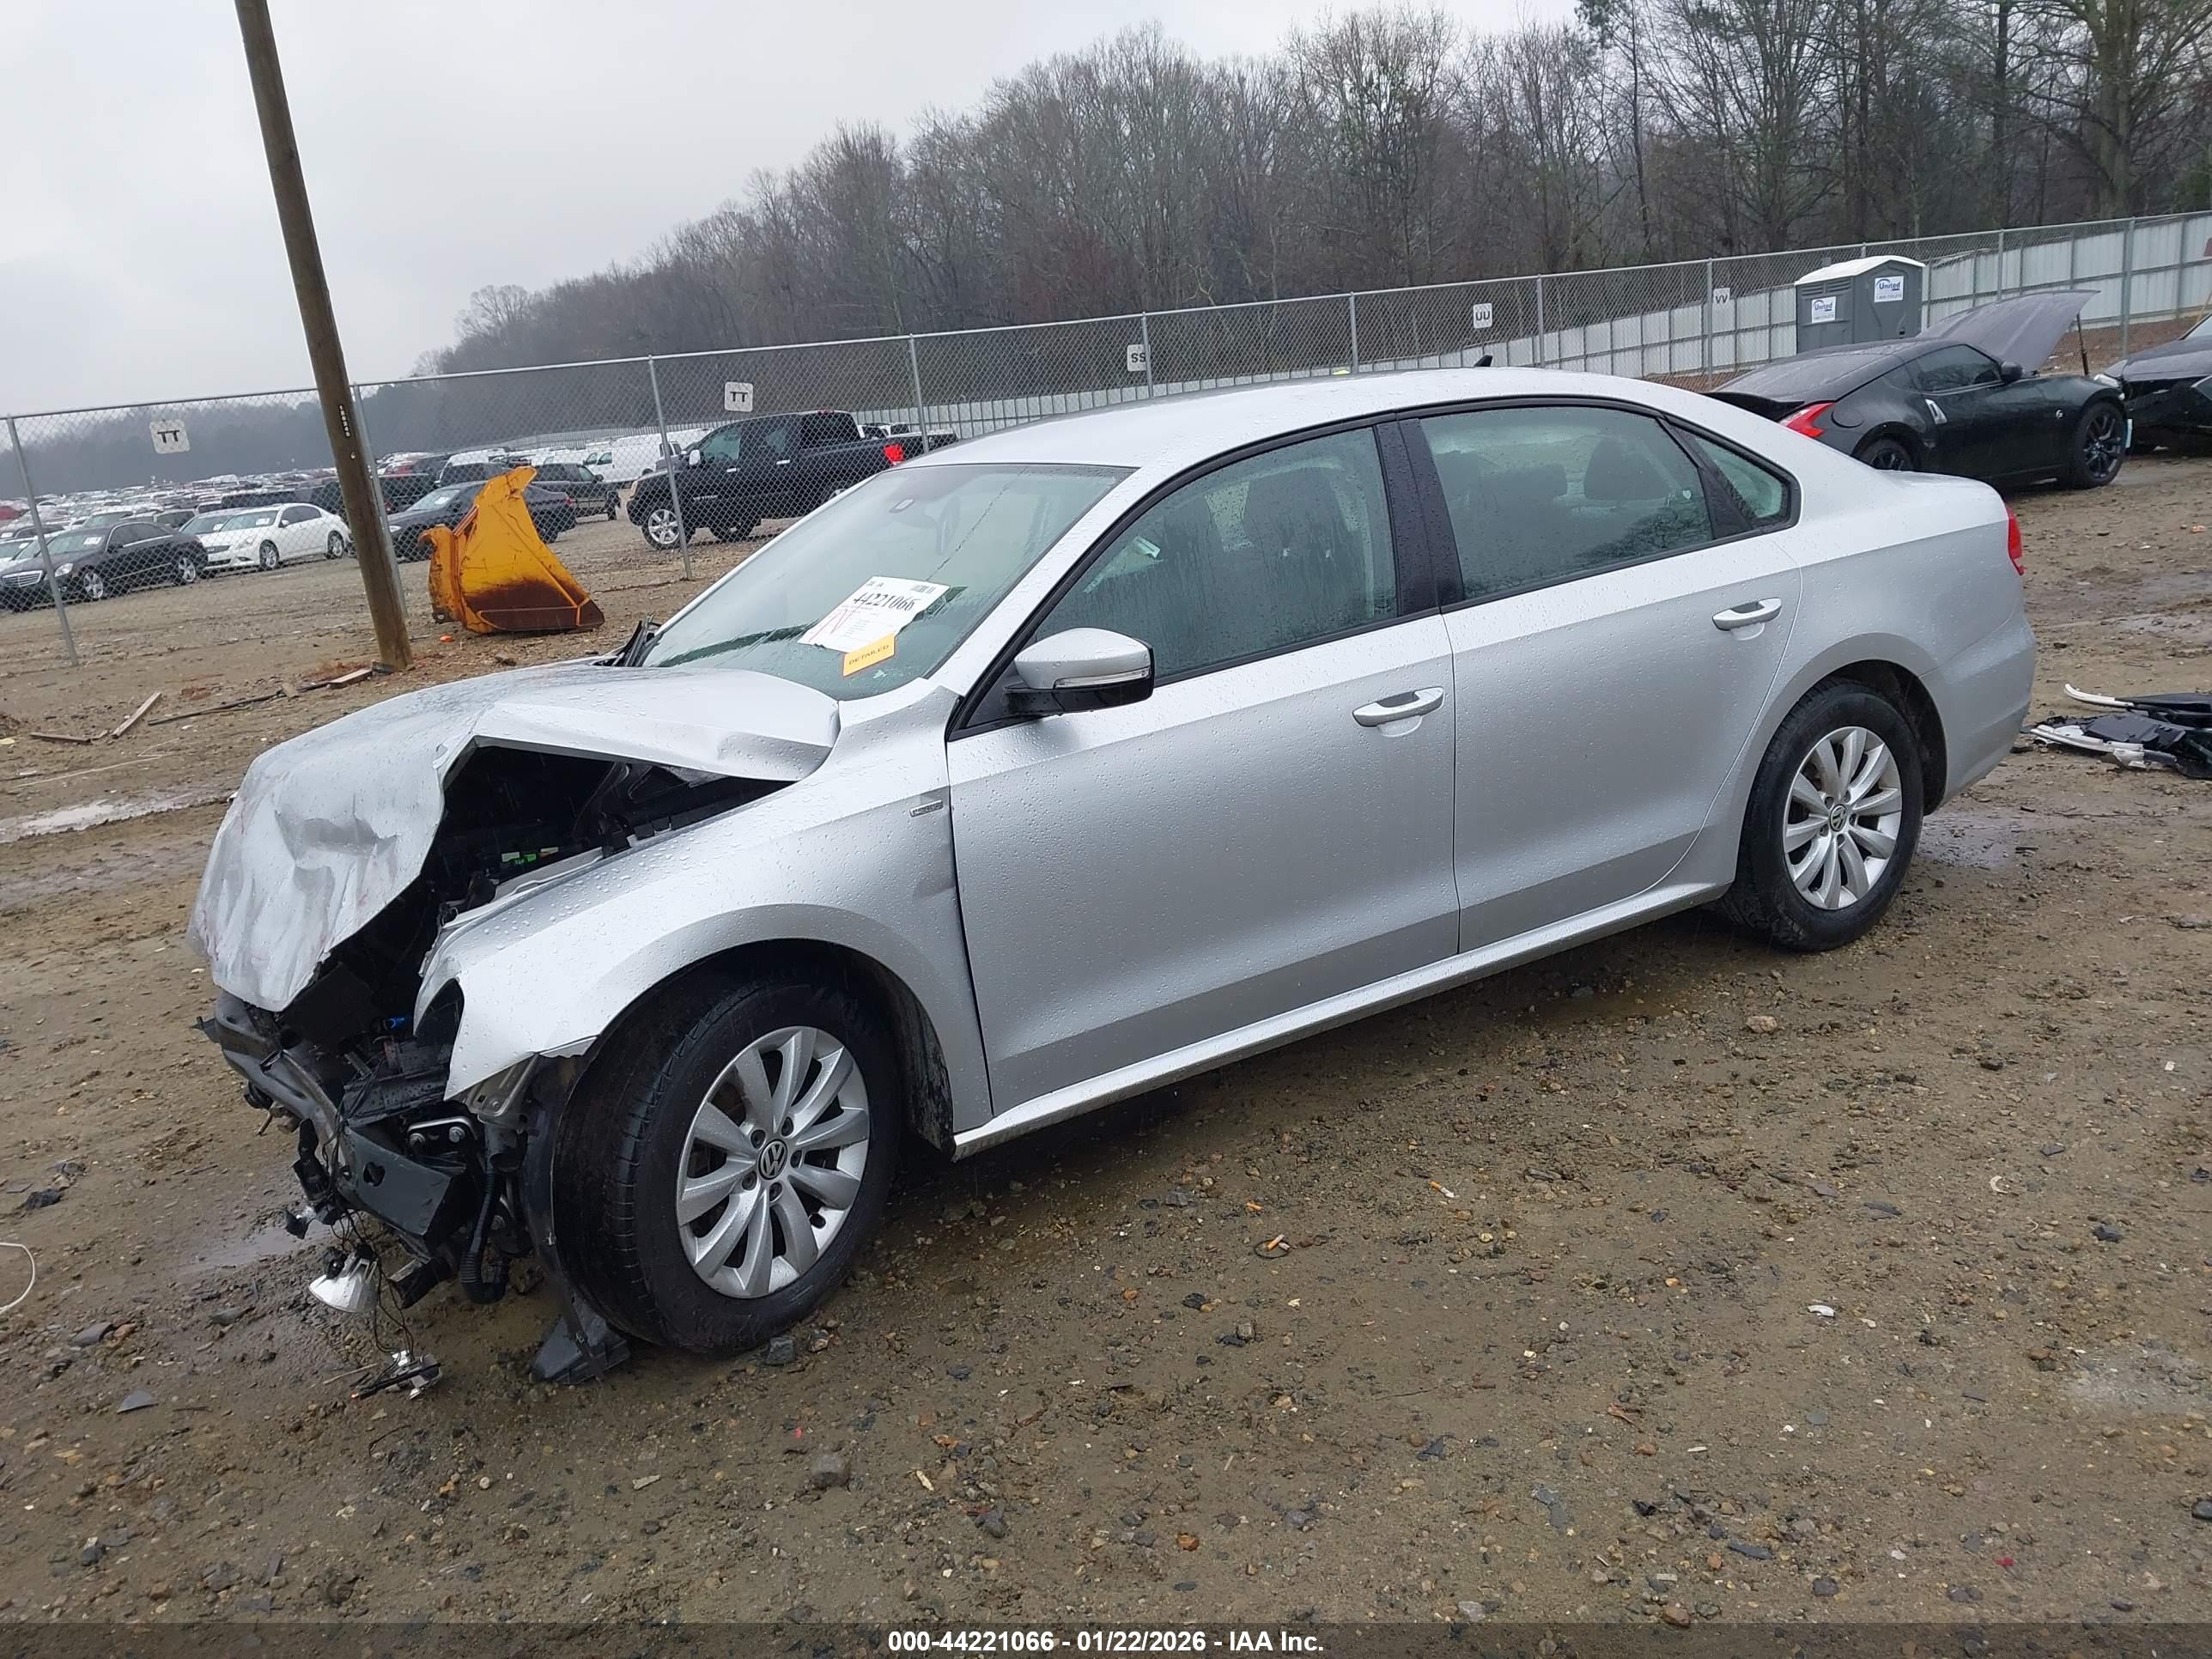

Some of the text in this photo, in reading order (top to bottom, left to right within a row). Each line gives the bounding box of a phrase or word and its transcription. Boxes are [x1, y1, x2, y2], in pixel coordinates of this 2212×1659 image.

[1879, 281, 1901, 290] United
[1814, 301, 1833, 311] United
[1475, 310, 1491, 321] UU
[1131, 352, 1146, 363] SS
[730, 391, 748, 403] TT
[156, 429, 180, 444] TT
[853, 592, 921, 611] 44221066
[848, 644, 890, 665] DETAILED
